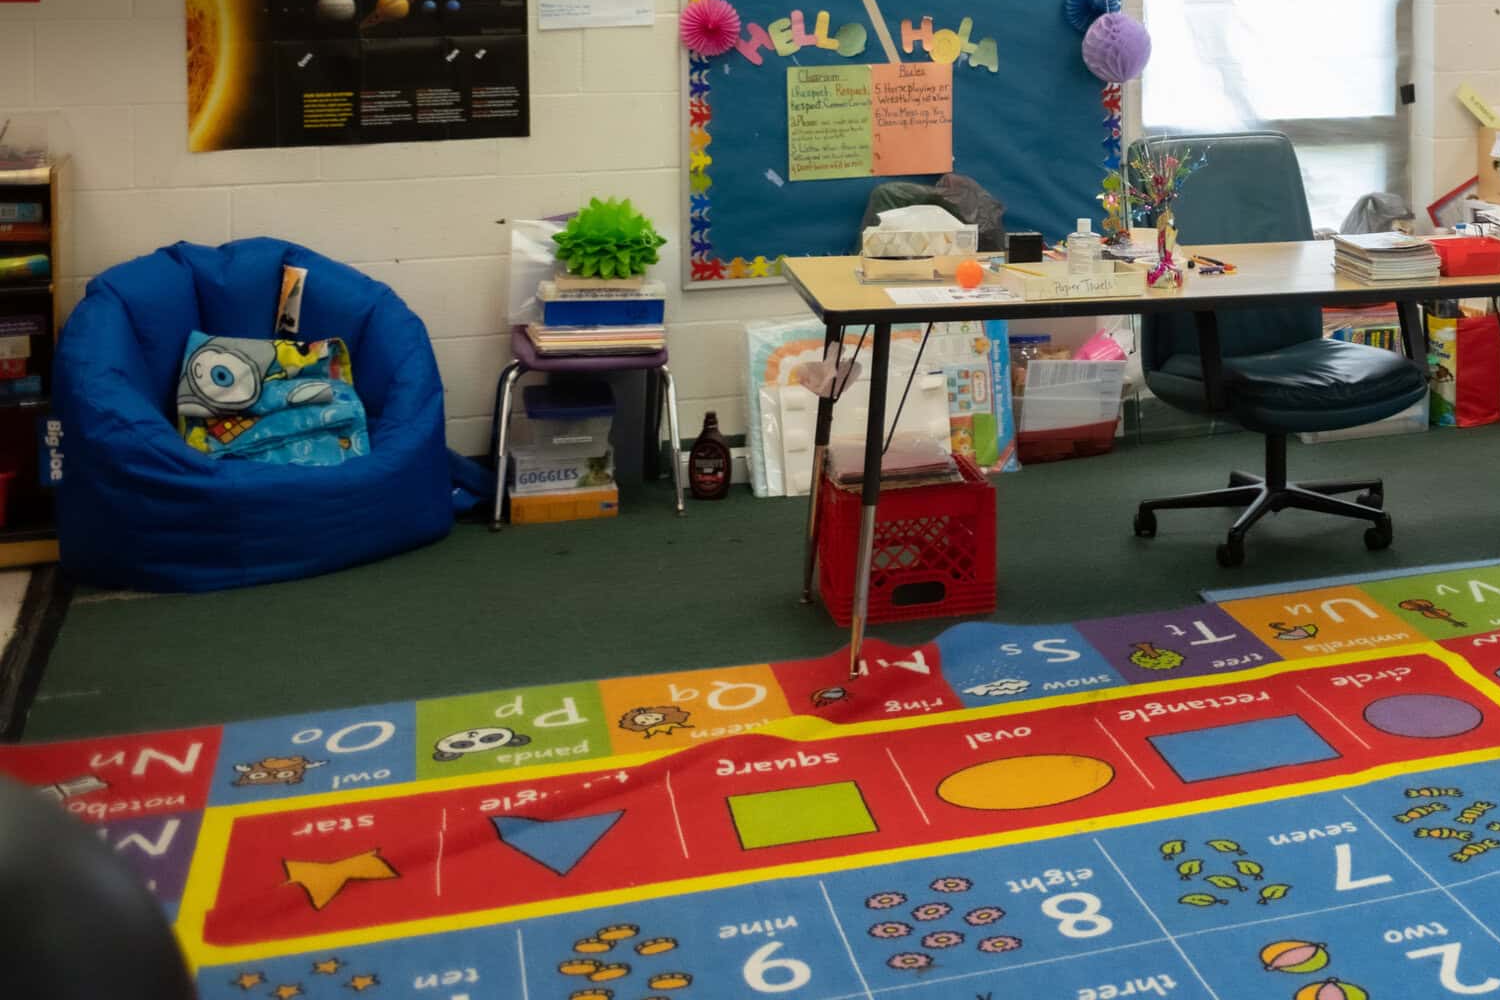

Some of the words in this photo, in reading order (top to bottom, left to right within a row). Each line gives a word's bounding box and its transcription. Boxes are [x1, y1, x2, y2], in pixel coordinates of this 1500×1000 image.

[734, 10, 868, 66] HELLO
[901, 16, 999, 73] HOLA
[45, 420, 63, 446] Big
[50, 448, 64, 480] Joe
[518, 468, 579, 485] GOGGLES
[1303, 632, 1410, 653] umbrella
[1213, 651, 1264, 669] tree
[1043, 674, 1112, 690] snow
[1331, 666, 1412, 688] circle
[885, 697, 944, 712] ring
[1119, 690, 1270, 723] rectangle
[966, 726, 1032, 749] oval
[495, 739, 590, 766] panda
[715, 751, 840, 777] square
[332, 769, 392, 790] owl
[293, 814, 375, 836] star
[1268, 821, 1358, 847] seven
[1334, 843, 1393, 891] 7
[1004, 868, 1094, 894] eight
[719, 916, 798, 939] nine
[1041, 892, 1113, 938] 8
[1383, 921, 1449, 944] two
[413, 967, 479, 990] ten
[743, 941, 812, 993] 9
[1078, 972, 1177, 1000] three
